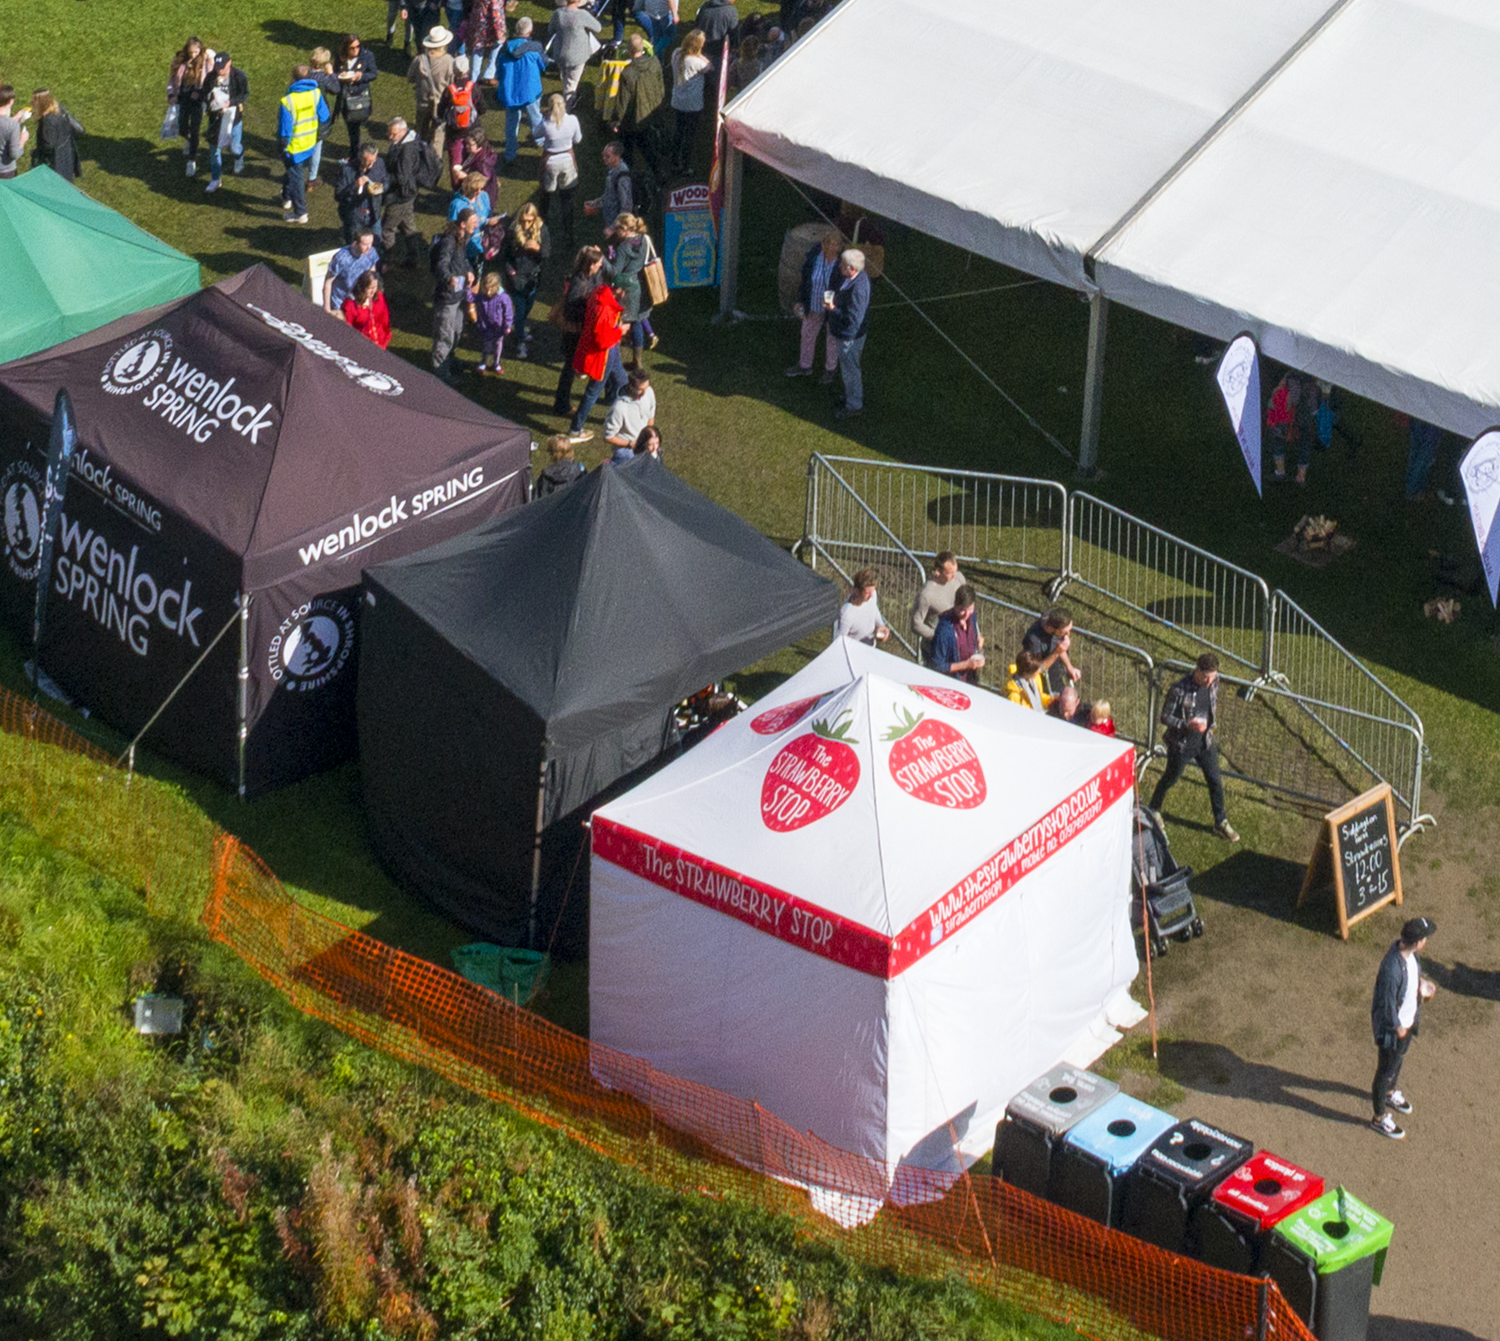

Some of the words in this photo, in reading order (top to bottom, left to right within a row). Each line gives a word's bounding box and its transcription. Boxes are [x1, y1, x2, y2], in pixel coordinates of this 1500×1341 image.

[142, 381, 221, 445] SPRING
[167, 356, 273, 445] wenlock
[71, 449, 113, 495] nlock
[114, 484, 162, 531] SPRING
[298, 494, 410, 566] wenlock
[411, 467, 485, 517] SPRING
[55, 556, 150, 656] SPRING
[60, 512, 204, 647] wenlock
[279, 618, 292, 635] AT
[814, 744, 833, 768] The
[896, 736, 973, 794] STRAWBERRY
[912, 733, 936, 752] The
[762, 784, 809, 824] STOP
[769, 751, 850, 811] STRAWBERRY
[933, 768, 980, 808] STOP
[642, 846, 673, 880] The
[674, 859, 786, 934] STRAWBERRY
[791, 905, 834, 946] STOP
